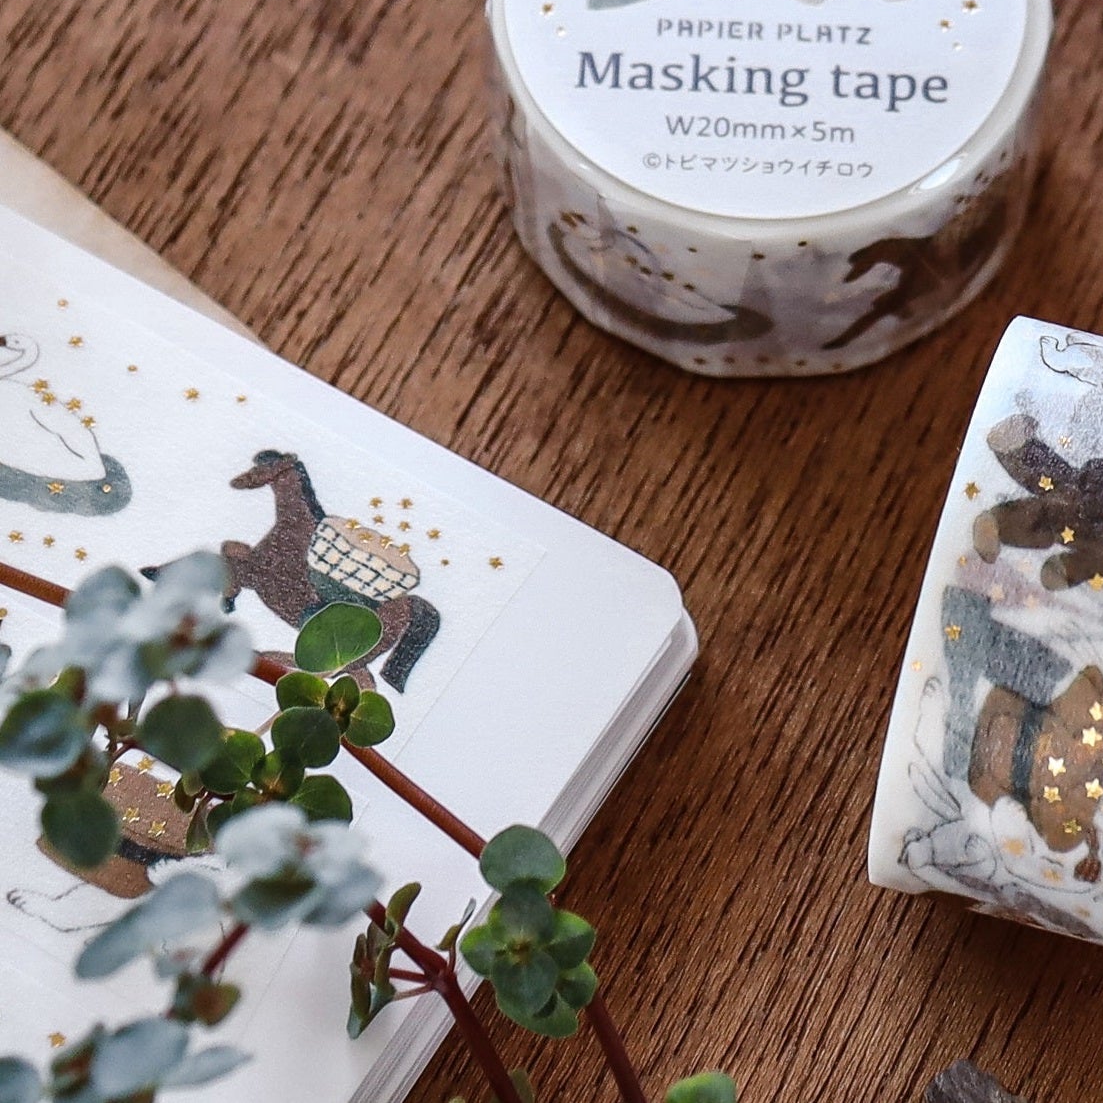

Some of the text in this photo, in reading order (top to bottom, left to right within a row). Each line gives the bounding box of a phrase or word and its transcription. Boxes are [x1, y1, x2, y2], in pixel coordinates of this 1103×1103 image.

[657, 18, 872, 45] PAPIER PLATZ
[575, 51, 949, 112] Masking tape
